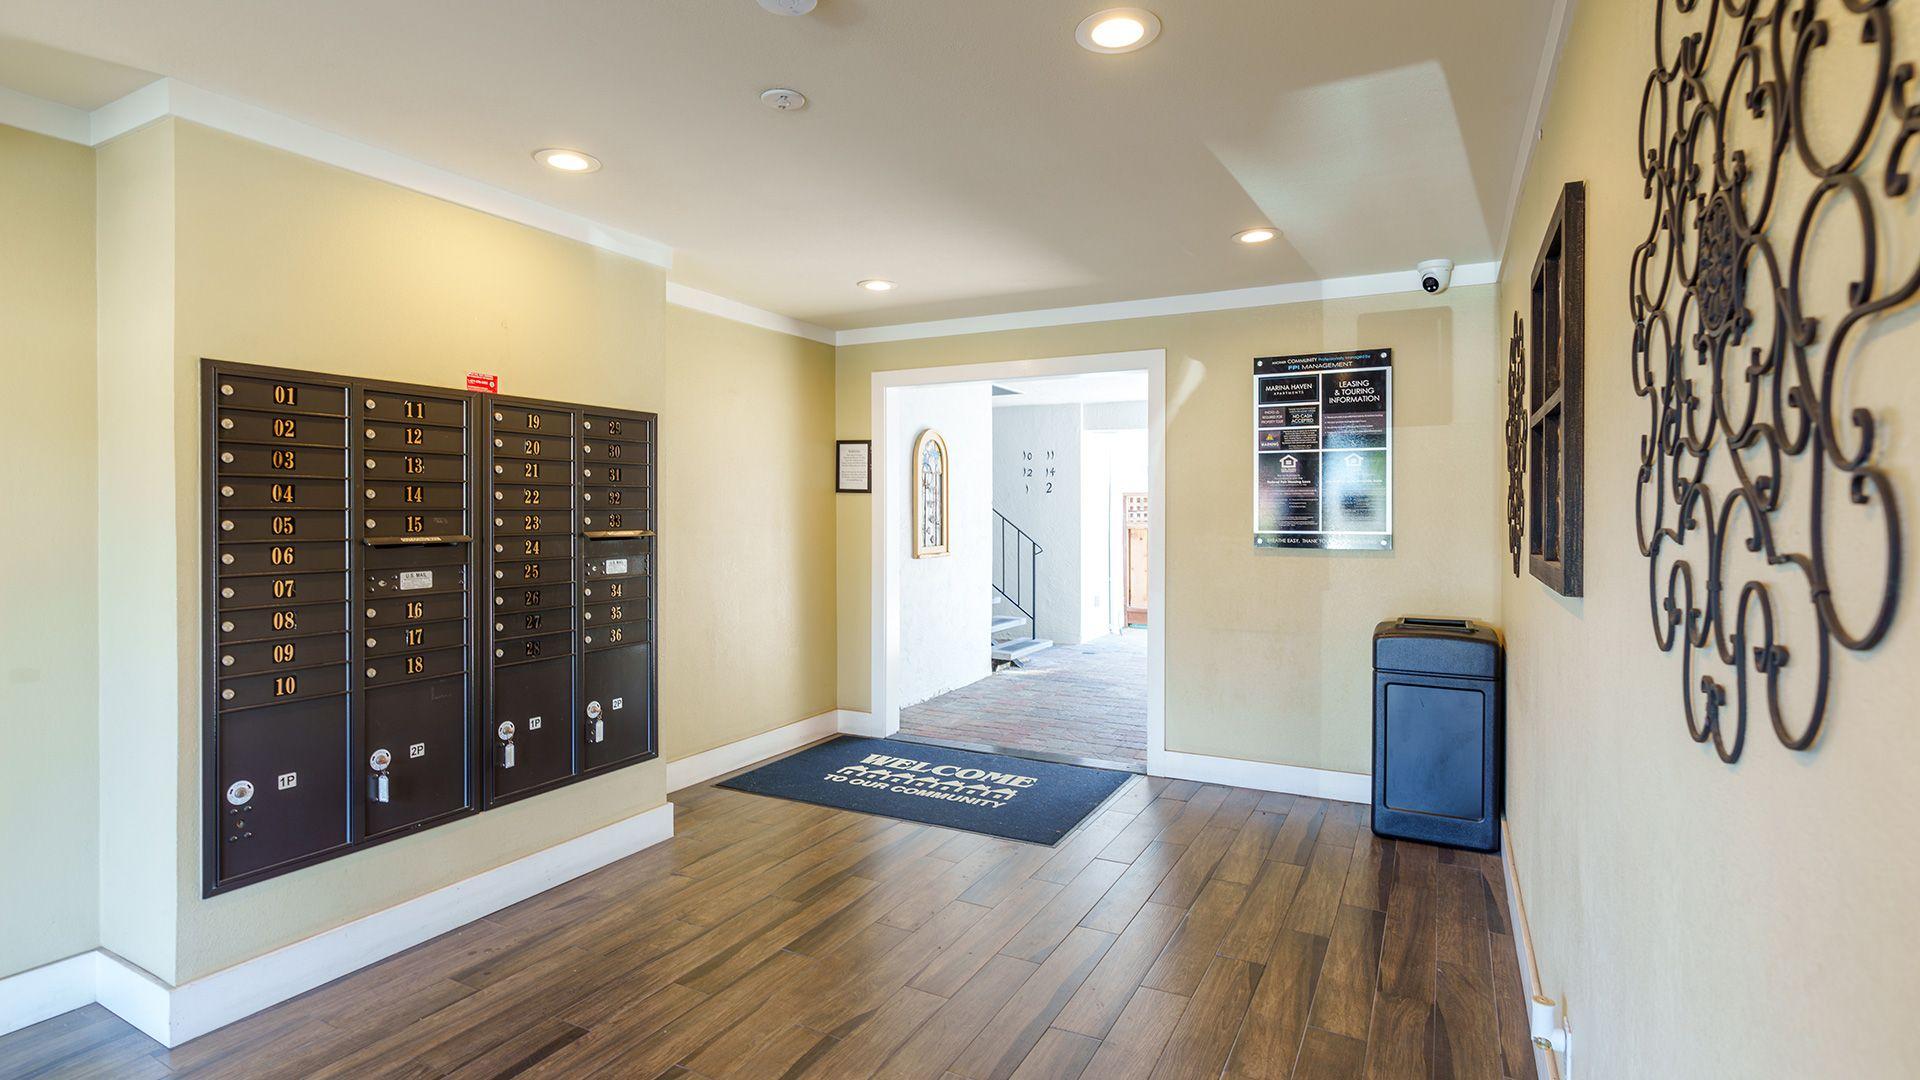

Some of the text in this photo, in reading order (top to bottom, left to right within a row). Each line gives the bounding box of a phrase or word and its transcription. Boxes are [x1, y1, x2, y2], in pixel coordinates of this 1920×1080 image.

[1301, 361, 1353, 370] MANAGEMENT
[1339, 380, 1370, 388] LEASING
[275, 386, 295, 404] 01
[1342, 387, 1374, 396] TOURING
[1329, 395, 1380, 403] INFORMATION
[406, 403, 423, 418] 11
[274, 419, 294, 437] 02
[528, 415, 540, 428] 19
[610, 422, 620, 433] 29
[406, 429, 422, 444] 12
[526, 441, 539, 454] 20
[609, 446, 620, 457] 30
[273, 451, 294, 469] 03
[1023, 450, 1032, 460] 10
[407, 458, 422, 473] 13
[526, 464, 538, 477] 21
[610, 469, 620, 480] 31
[1023, 468, 1055, 477] 12 14
[272, 485, 293, 502] 04
[406, 486, 422, 502] 14
[1046, 482, 1052, 493] 2
[525, 490, 539, 503] 22
[609, 492, 620, 504] 32
[273, 516, 293, 534] 05
[406, 516, 422, 532] 15
[526, 516, 539, 529] 23
[610, 515, 620, 527] 33
[526, 541, 539, 554] 24
[272, 547, 293, 564] 06
[525, 565, 538, 577] 25
[274, 581, 294, 597] 07
[611, 584, 622, 596] 34
[526, 592, 538, 605] 26
[407, 603, 422, 618] 16
[611, 607, 621, 619] 35
[274, 612, 294, 629] 08
[527, 616, 539, 629] 27
[408, 629, 422, 645] 17
[611, 630, 622, 641] 36
[274, 644, 294, 662] 09
[527, 642, 540, 655] 28
[408, 657, 423, 673] 18
[276, 677, 295, 695] 10
[531, 719, 540, 728] 1P
[412, 746, 423, 756] 2P
[860, 754, 1038, 788] WELCOME
[280, 775, 294, 786] 1P
[824, 774, 1007, 808] TO OUR COMMUNITY
